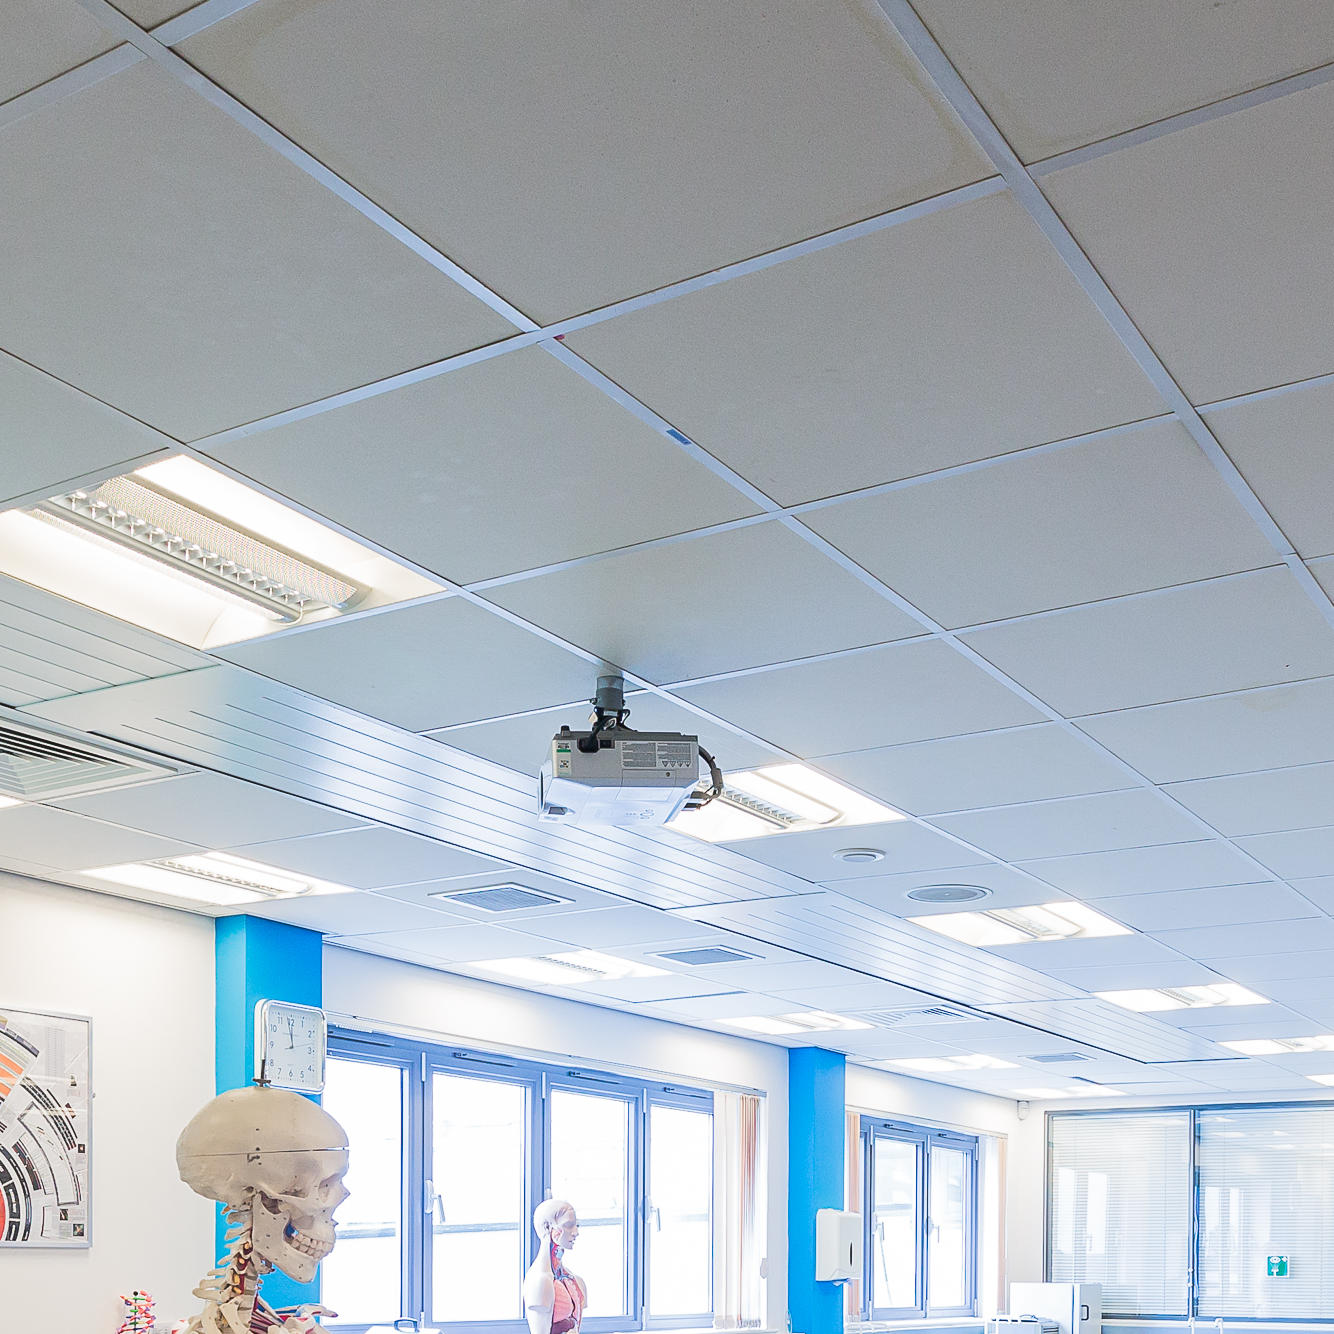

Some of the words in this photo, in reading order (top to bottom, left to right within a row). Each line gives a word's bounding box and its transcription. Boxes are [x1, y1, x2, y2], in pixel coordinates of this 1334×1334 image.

[270, 1024, 277, 1032] 10
[308, 1030, 312, 1038] 2
[269, 1040, 274, 1048] 9
[307, 1047, 312, 1055] 3
[269, 1059, 274, 1067] 8
[307, 1064, 312, 1072] 4
[288, 1069, 293, 1077] 6
